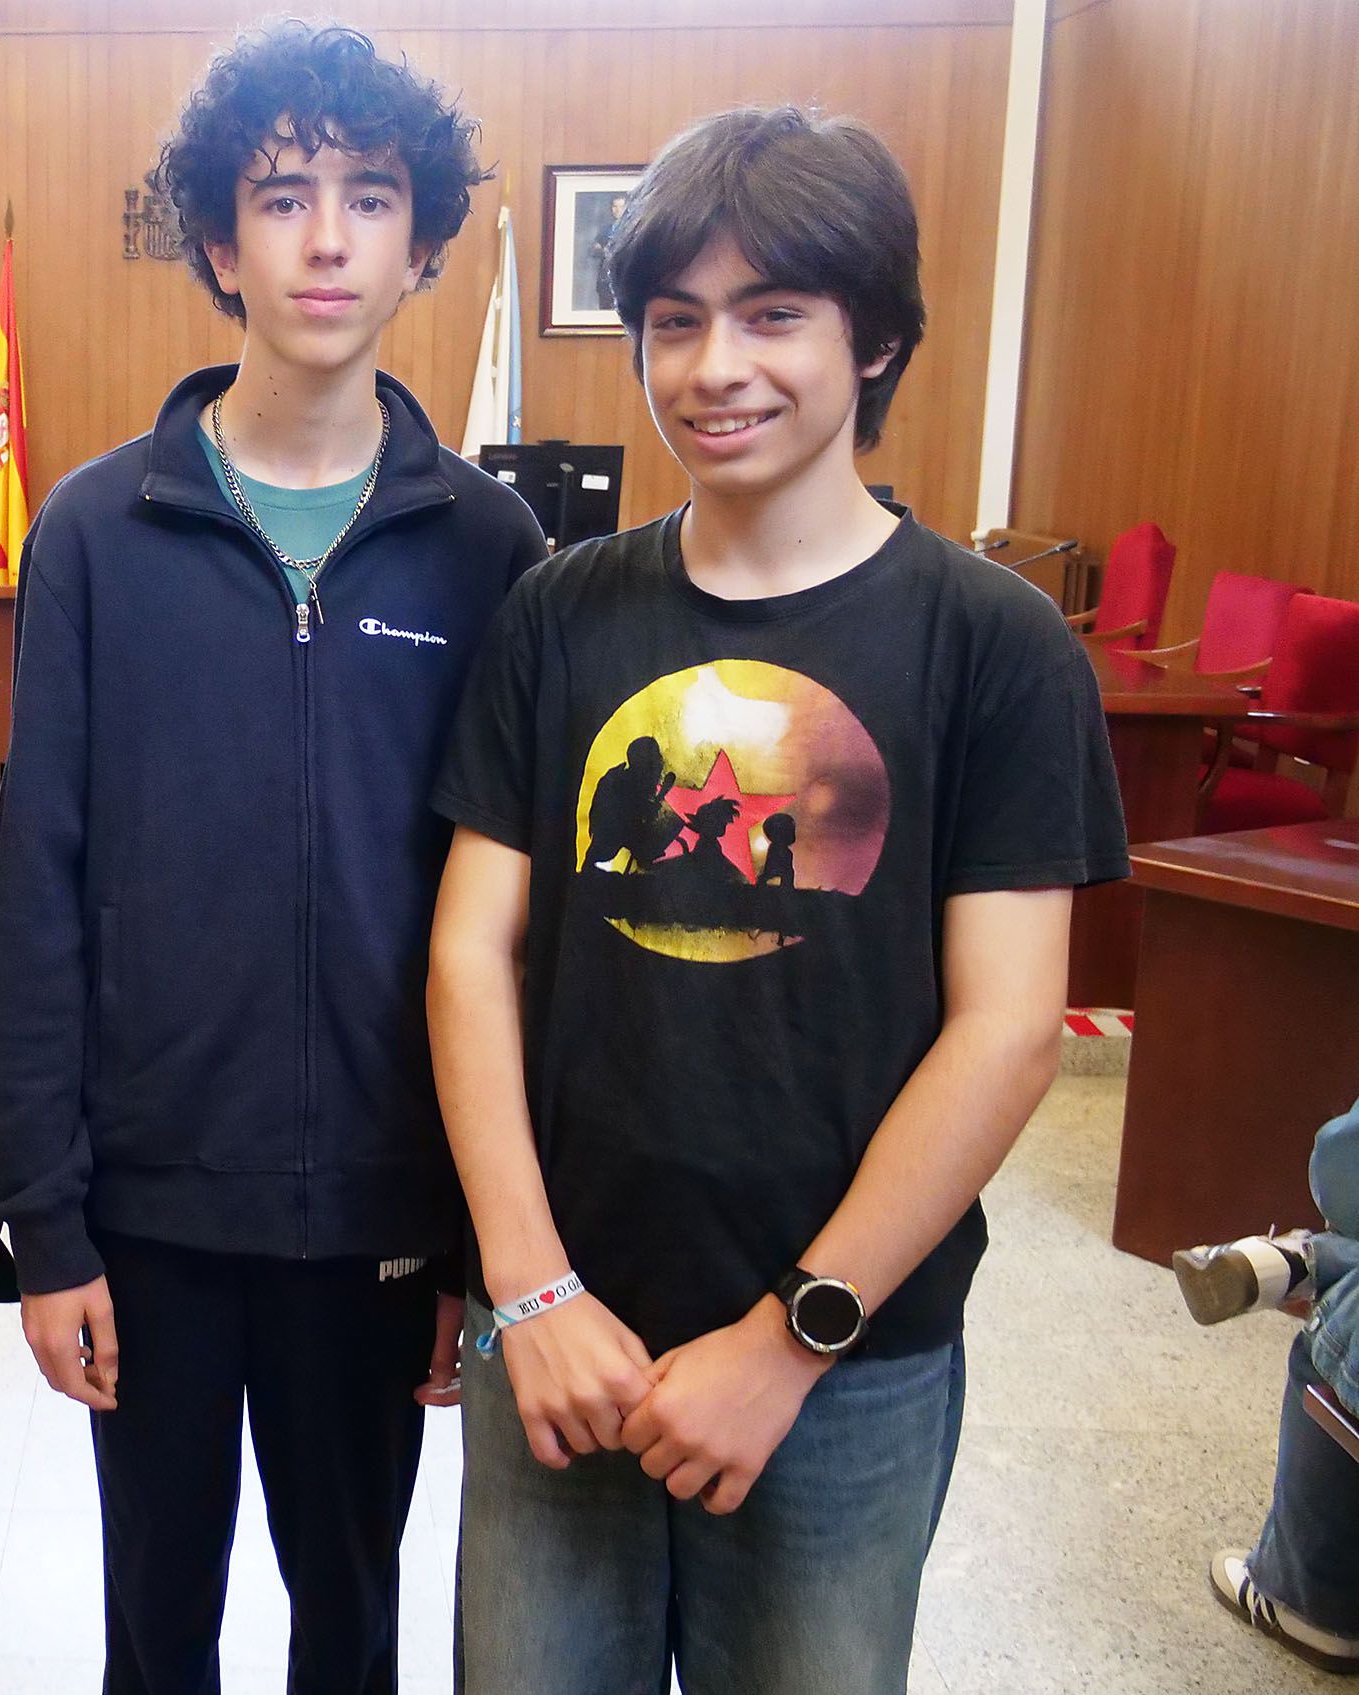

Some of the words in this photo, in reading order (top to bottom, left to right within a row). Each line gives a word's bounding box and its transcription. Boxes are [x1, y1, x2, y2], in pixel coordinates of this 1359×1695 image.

[359, 618, 448, 646] Champion
[517, 1299, 540, 1315] EU
[556, 1285, 567, 1297] O
